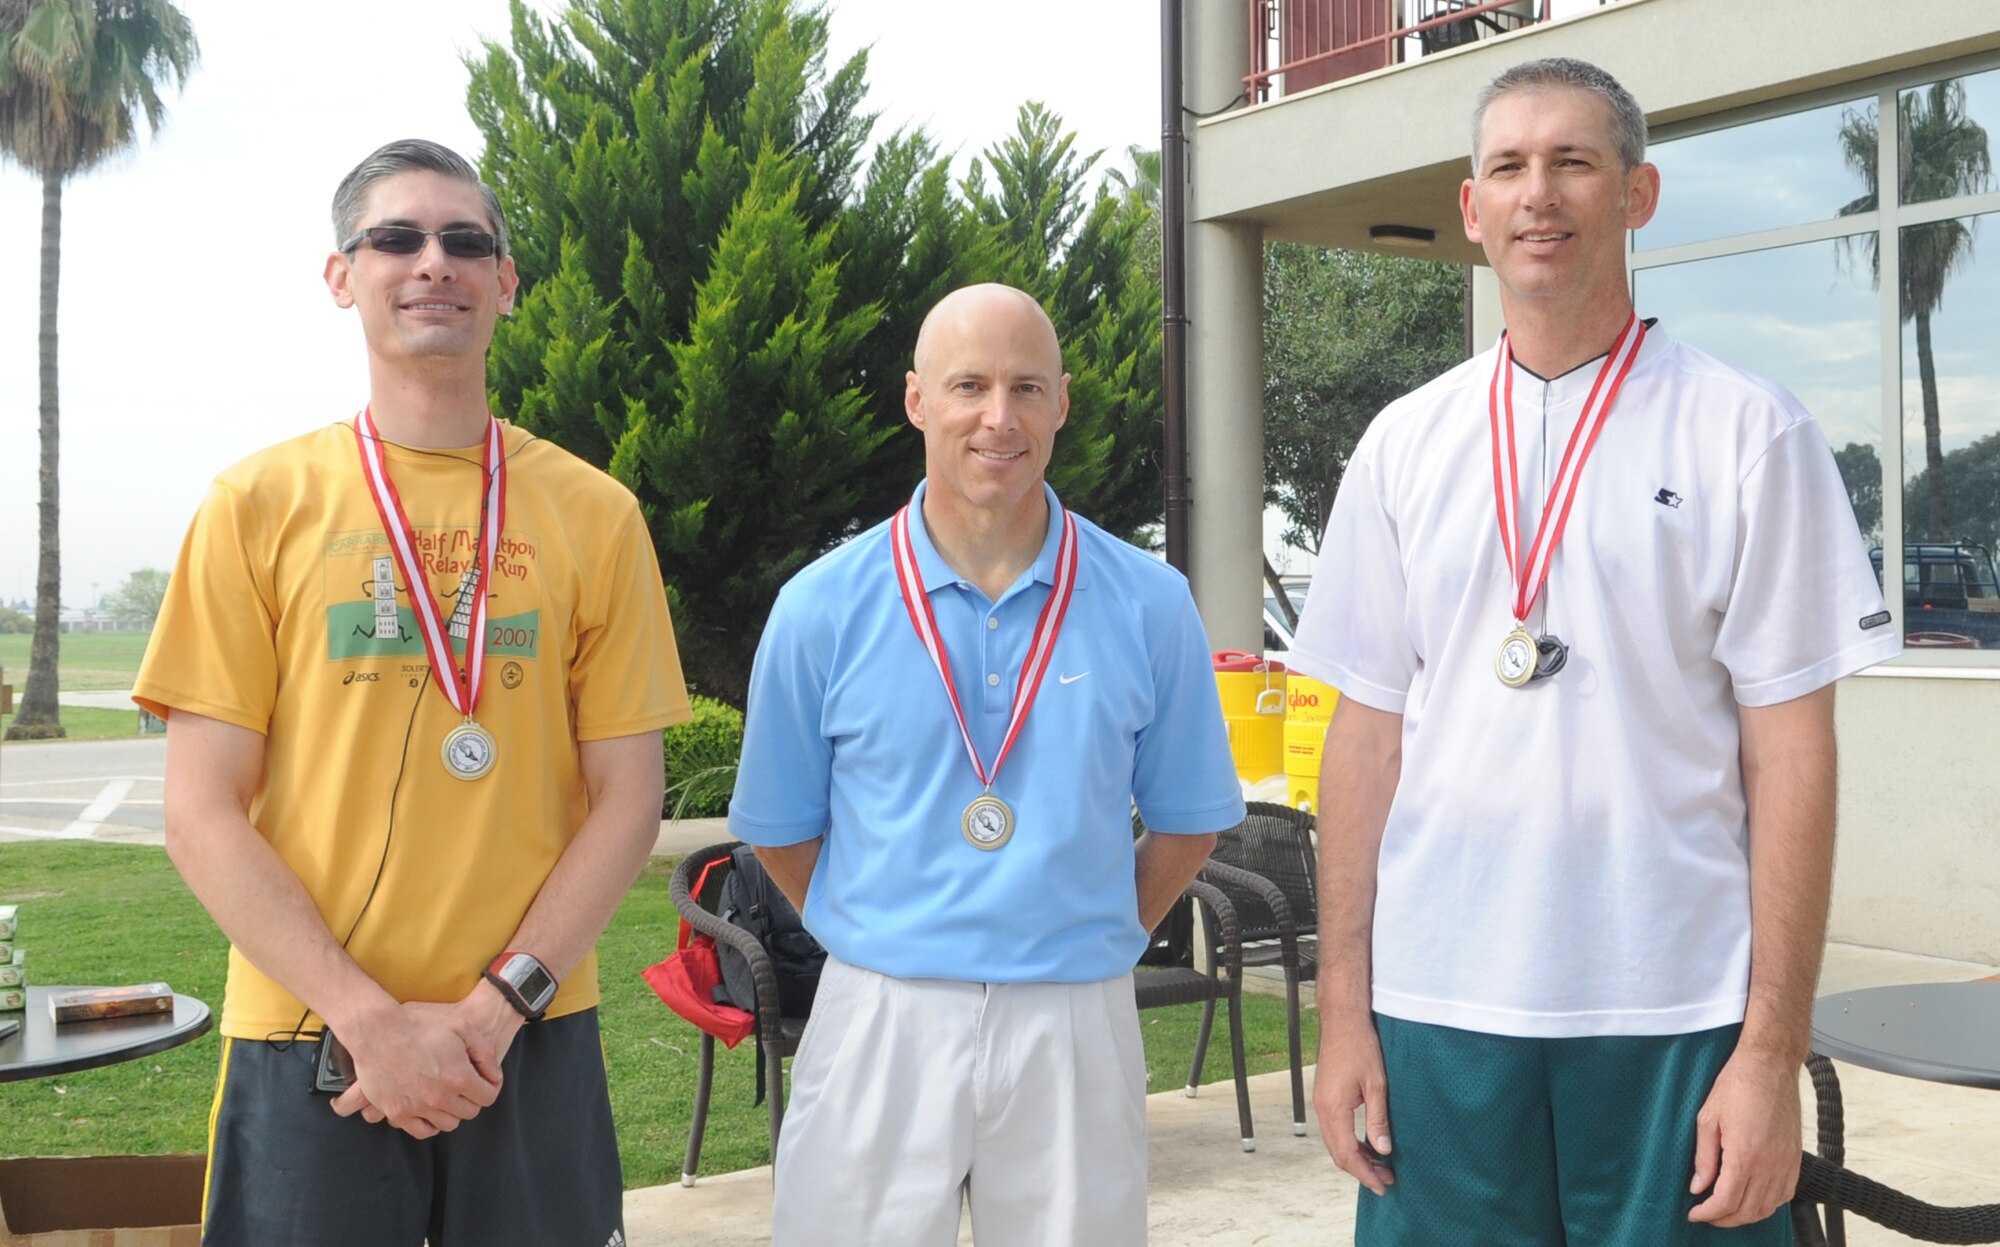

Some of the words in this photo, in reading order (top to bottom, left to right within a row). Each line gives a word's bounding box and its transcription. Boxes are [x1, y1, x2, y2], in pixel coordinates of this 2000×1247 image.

[412, 530, 447, 558] Half
[451, 530, 535, 560] Mathon
[421, 553, 470, 578] Relay
[495, 554, 528, 581] Run
[493, 627, 535, 648] 2007
[1288, 688, 1319, 712] igloo
